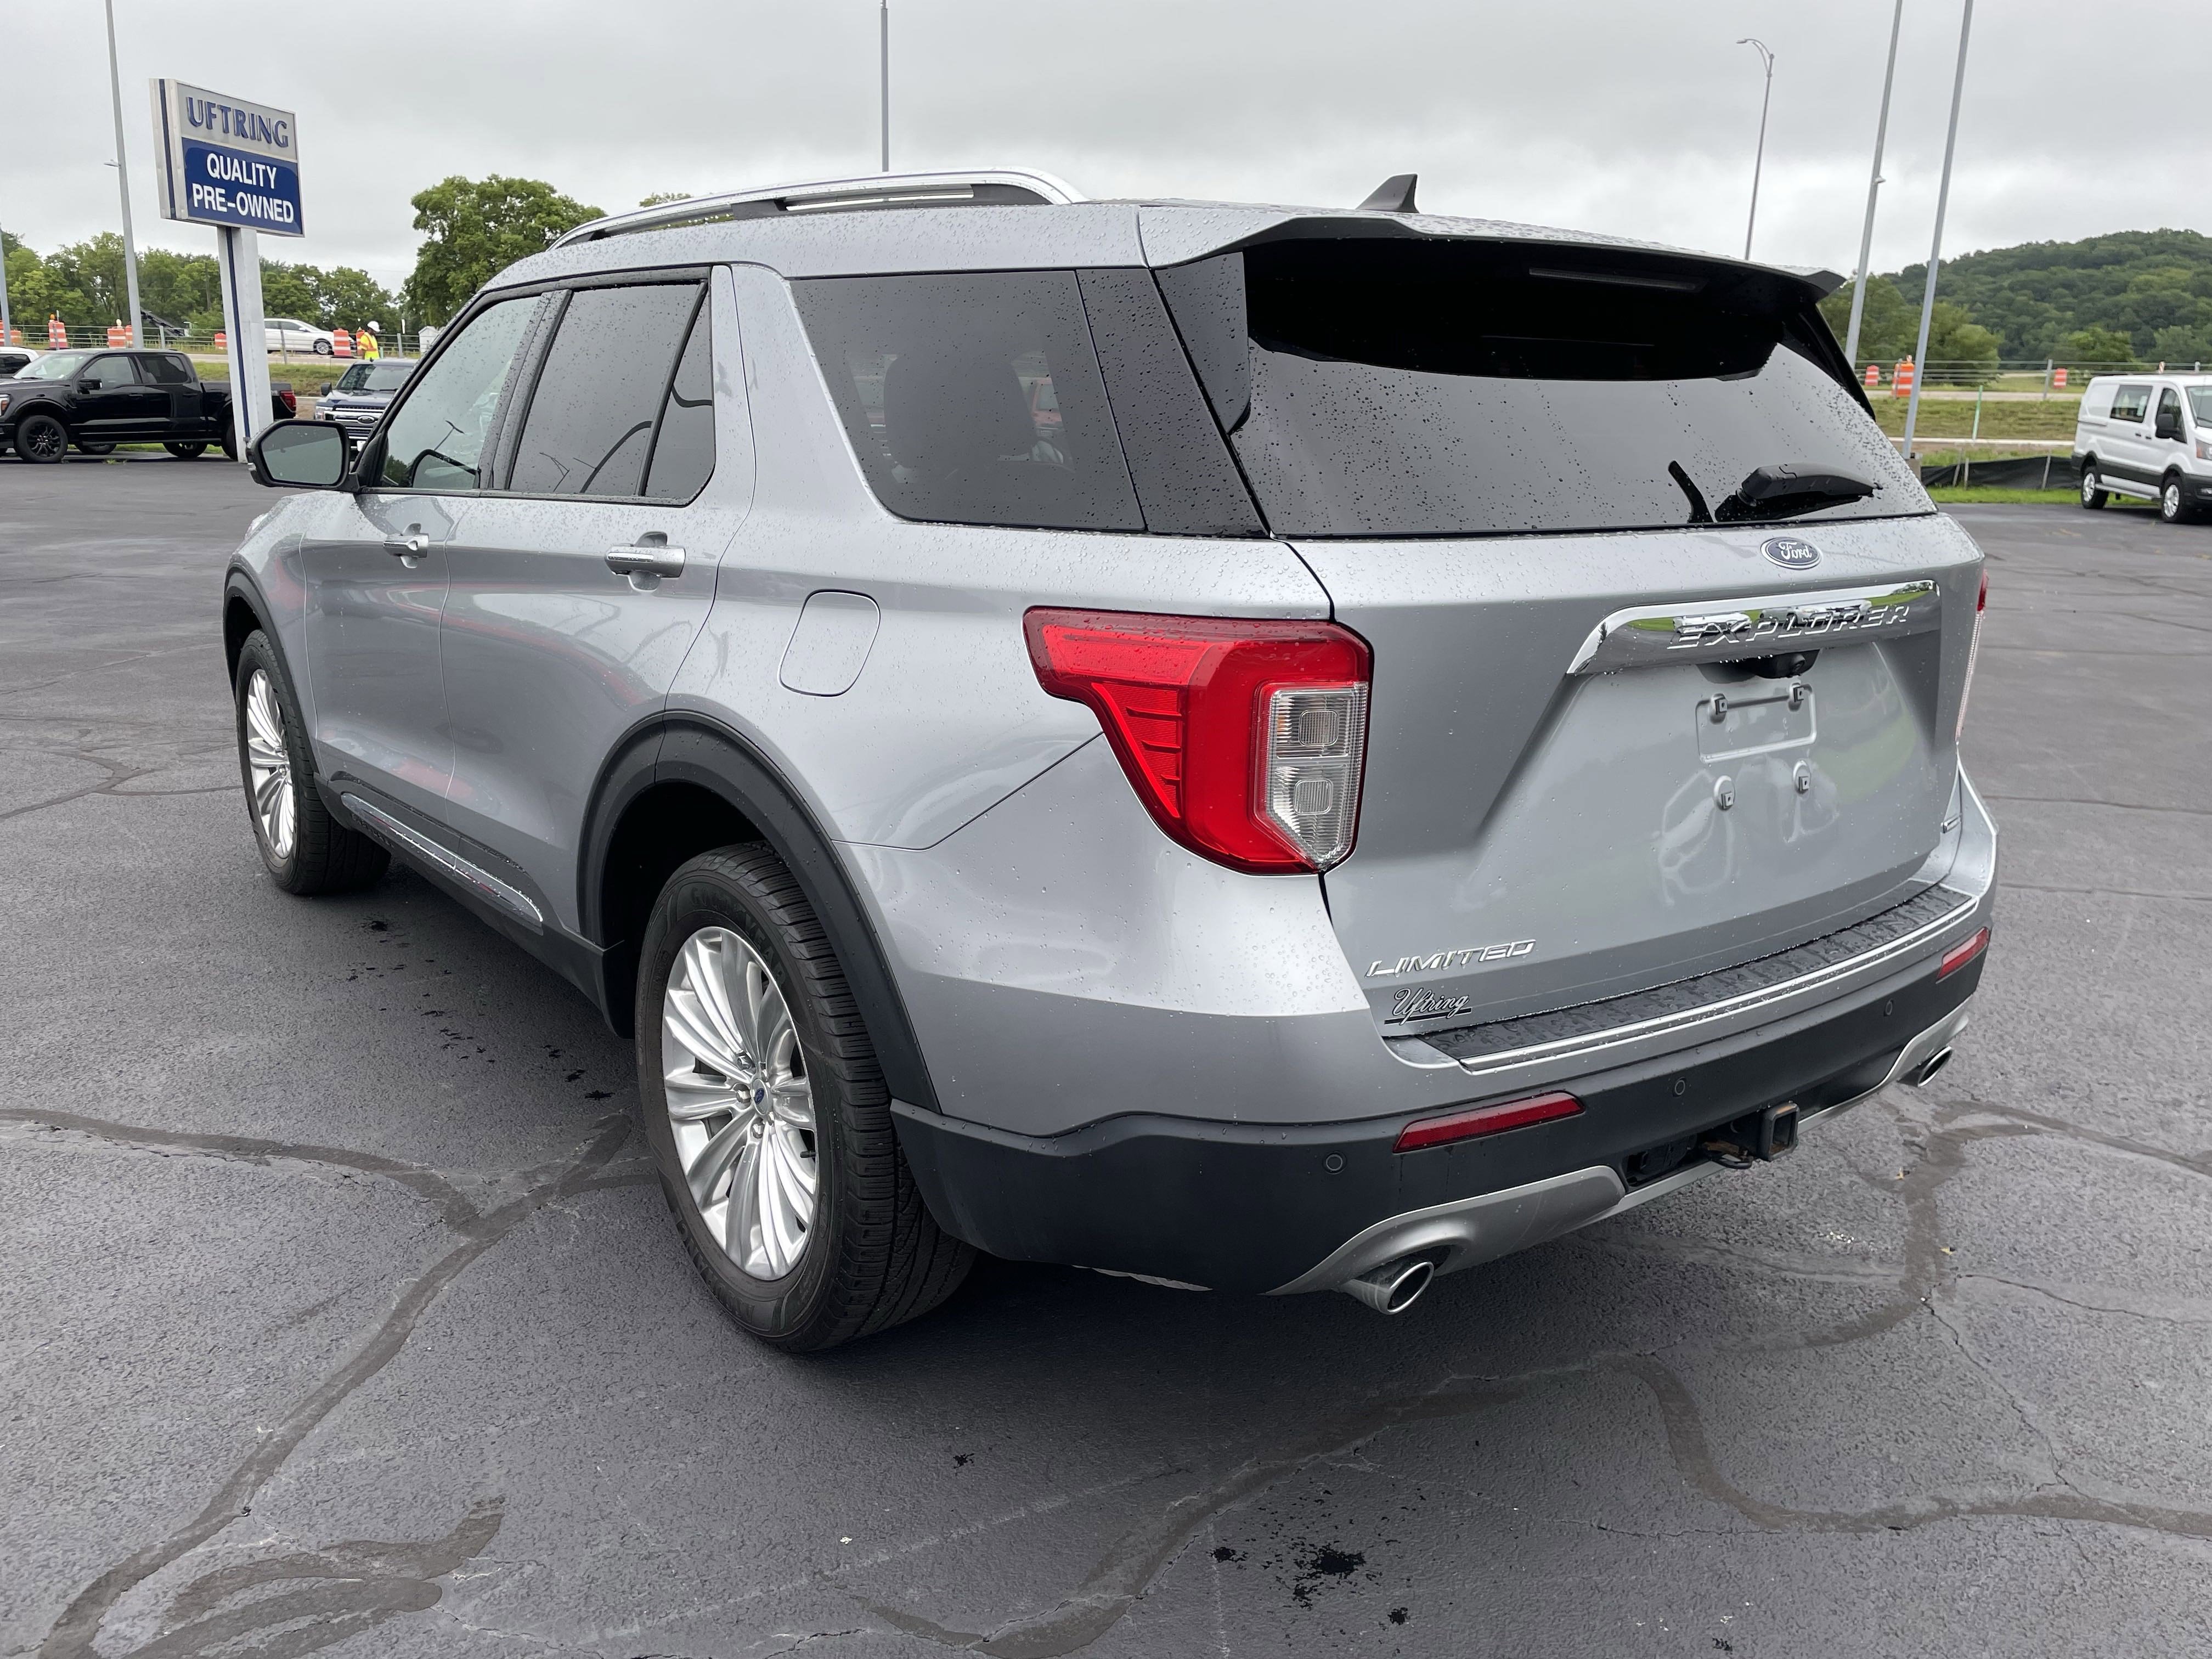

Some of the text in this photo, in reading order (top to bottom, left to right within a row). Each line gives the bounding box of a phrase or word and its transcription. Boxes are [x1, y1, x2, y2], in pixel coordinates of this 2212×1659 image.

[186, 97, 289, 148] UFTRING
[206, 153, 276, 189] QUALITY
[192, 183, 294, 223] PRE-OWNED
[1778, 541, 1812, 560] Ford
[1667, 605, 1910, 650] EXPLORER
[1364, 939, 1536, 978] LIMITED
[1392, 988, 1470, 1025] Uftring
